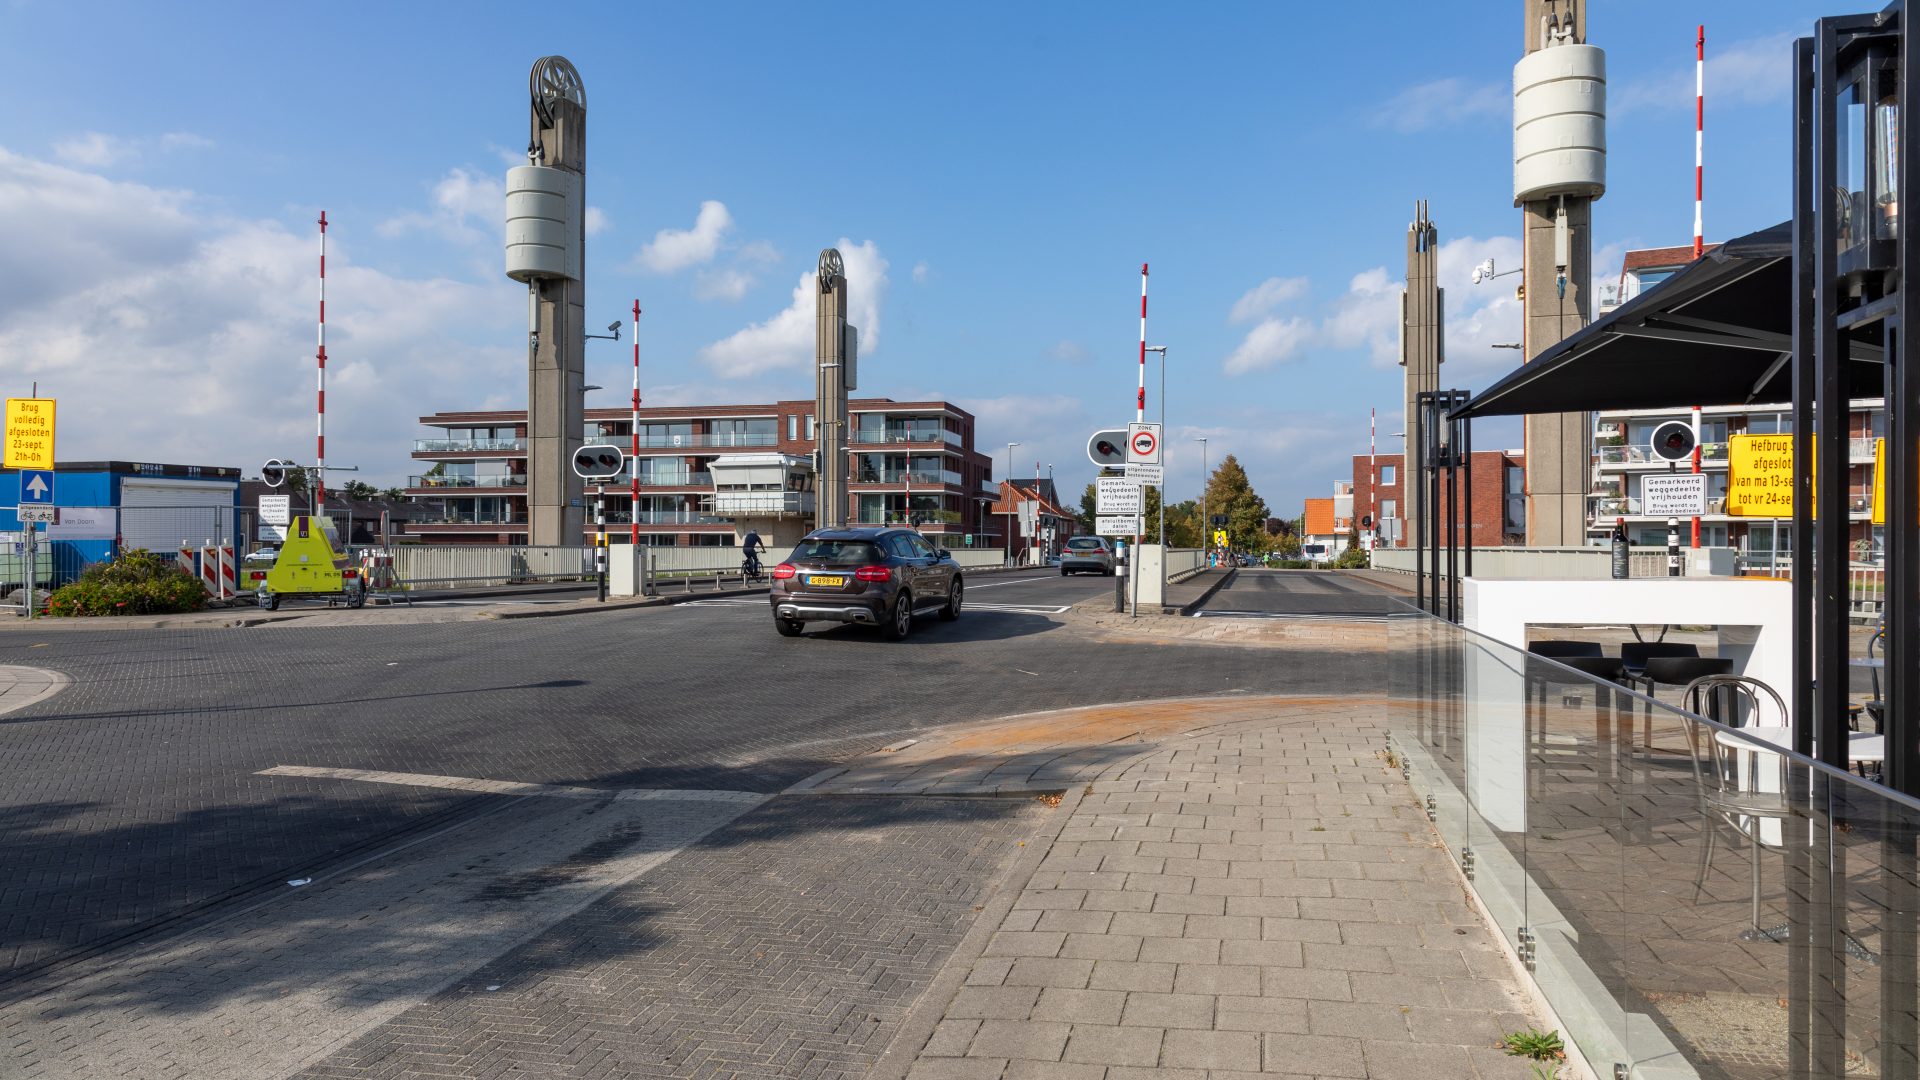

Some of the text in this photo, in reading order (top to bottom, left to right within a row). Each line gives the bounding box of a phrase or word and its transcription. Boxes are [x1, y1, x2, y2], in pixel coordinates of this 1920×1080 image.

[21, 403, 39, 414] Brug
[14, 415, 45, 427] volledig
[9, 427, 50, 439] afgesloten
[13, 440, 45, 451] 23-sept.
[1751, 439, 1788, 454] Hefbrug
[1753, 457, 1792, 472] afgeslot
[1736, 475, 1794, 487] van ma 13-se
[1738, 493, 1791, 505] tot vr 24-se
[811, 577, 841, 585] G-898-FX
